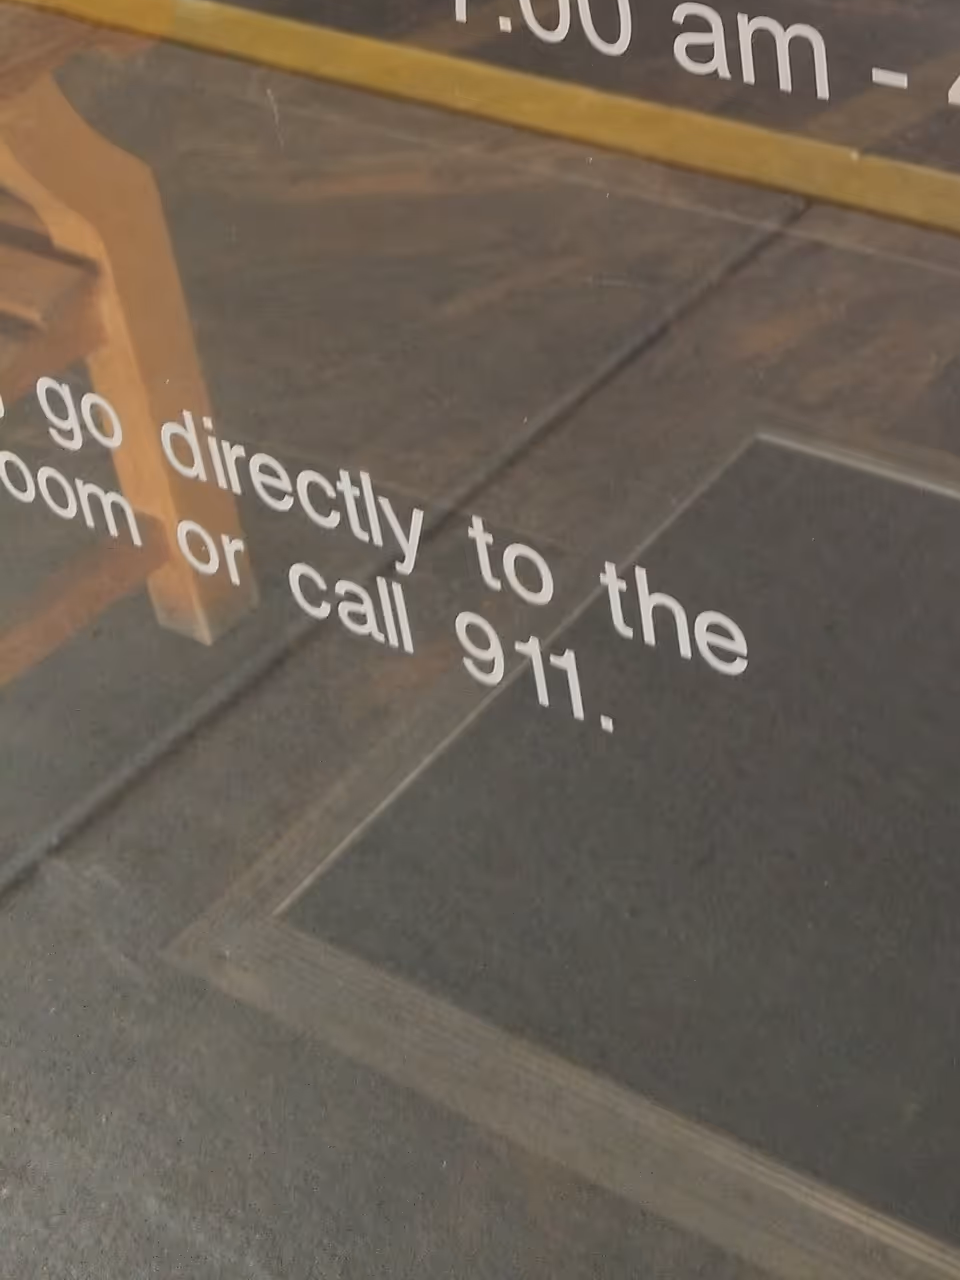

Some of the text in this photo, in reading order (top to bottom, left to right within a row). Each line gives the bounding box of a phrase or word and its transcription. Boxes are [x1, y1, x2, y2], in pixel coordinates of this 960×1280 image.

[671, 2, 830, 101] am
[872, 68, 908, 89] -
[36, 376, 749, 676] go directly to the
[176, 521, 245, 586] or
[288, 562, 415, 655] call
[454, 611, 614, 734] 911.
